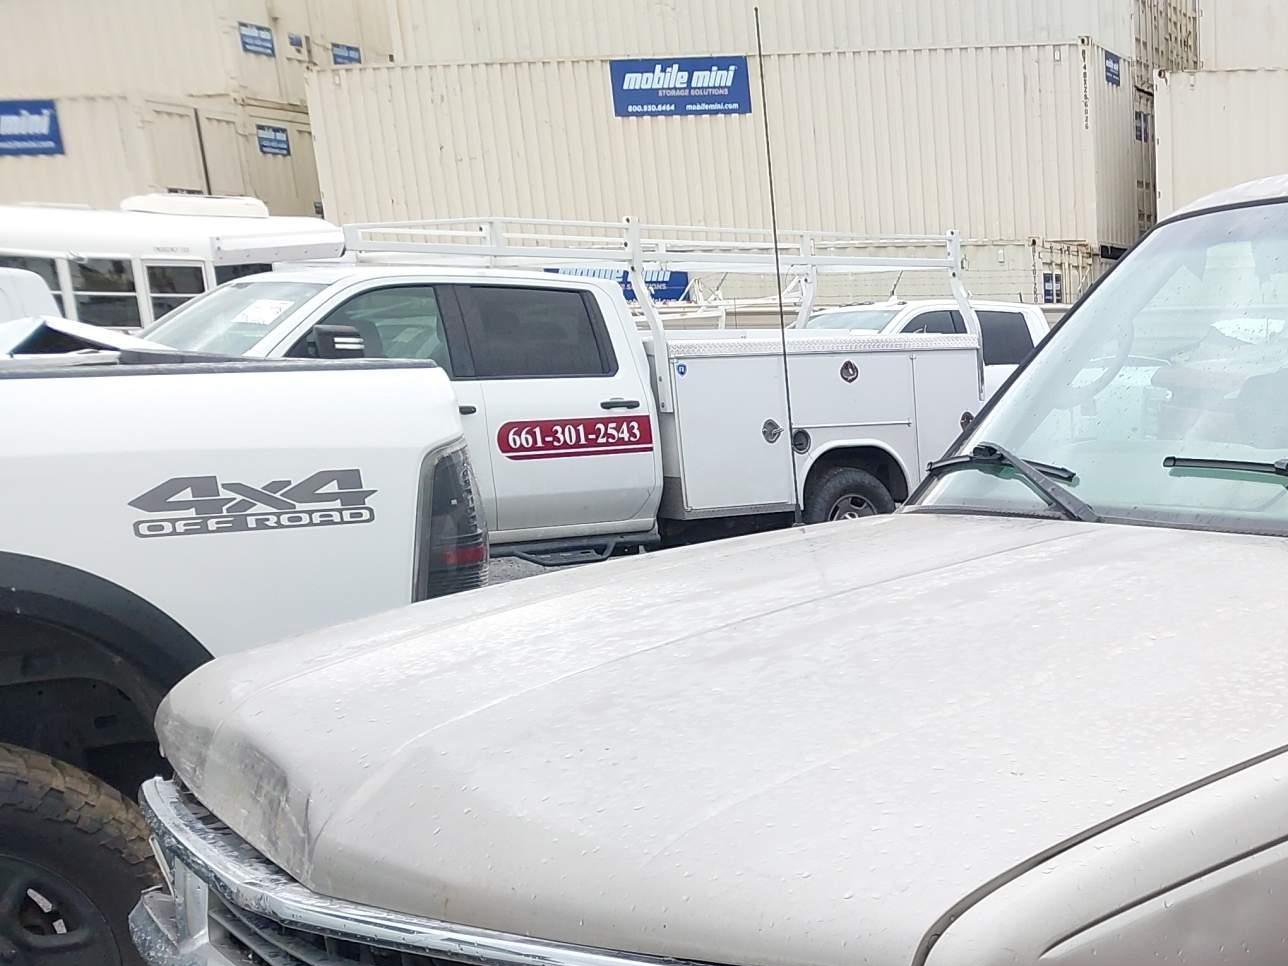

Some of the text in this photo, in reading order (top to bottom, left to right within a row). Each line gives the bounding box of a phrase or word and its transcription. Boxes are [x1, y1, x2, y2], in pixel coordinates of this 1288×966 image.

[623, 64, 737, 89] mobile mini
[508, 421, 641, 449] 661-301-2543
[138, 510, 371, 536] OFF ROAD
